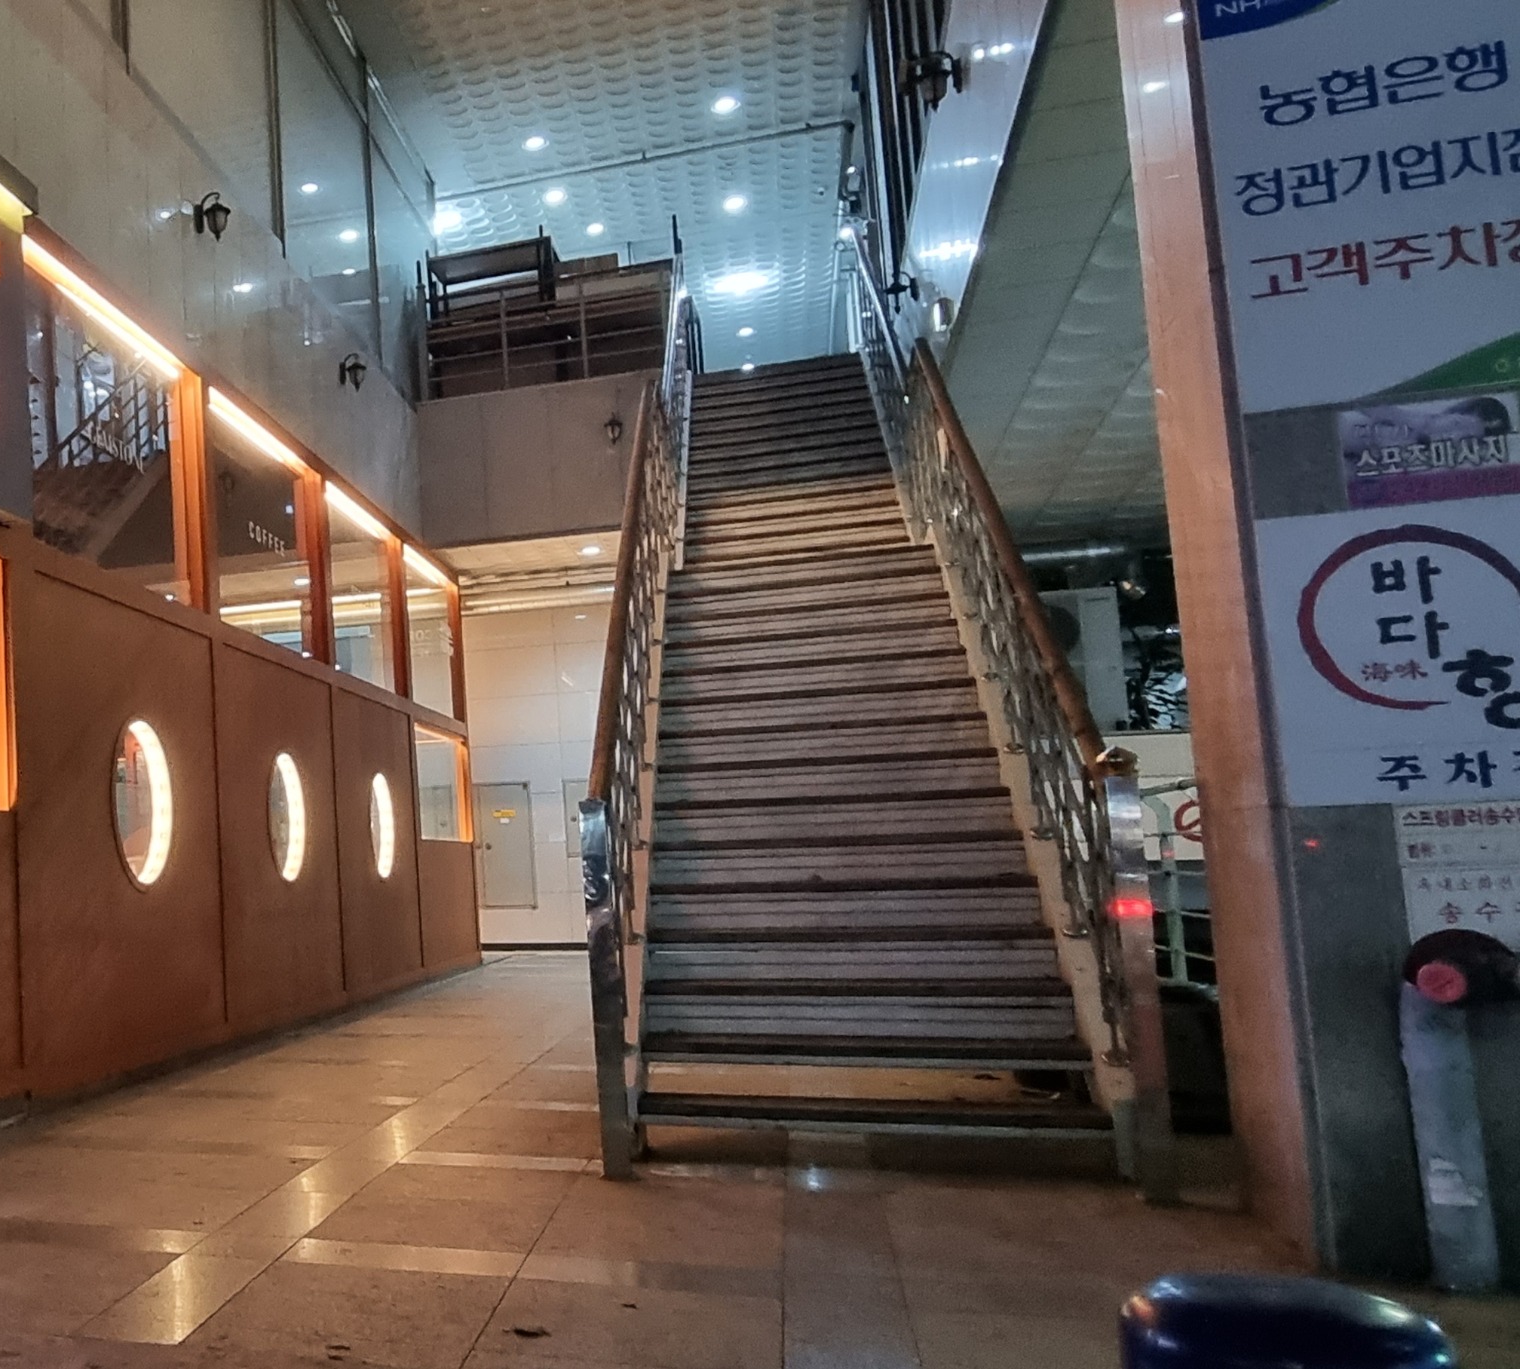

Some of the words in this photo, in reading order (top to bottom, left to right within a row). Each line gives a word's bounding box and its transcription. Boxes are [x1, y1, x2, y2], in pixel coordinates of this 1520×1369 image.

[1259, 40, 1508, 126] 농협은행
[1356, 434, 1507, 477] 스포츠마사지
[248, 520, 285, 558] COFFEE
[1377, 750, 1520, 792] 주차
[1438, 901, 1520, 924] 송수
